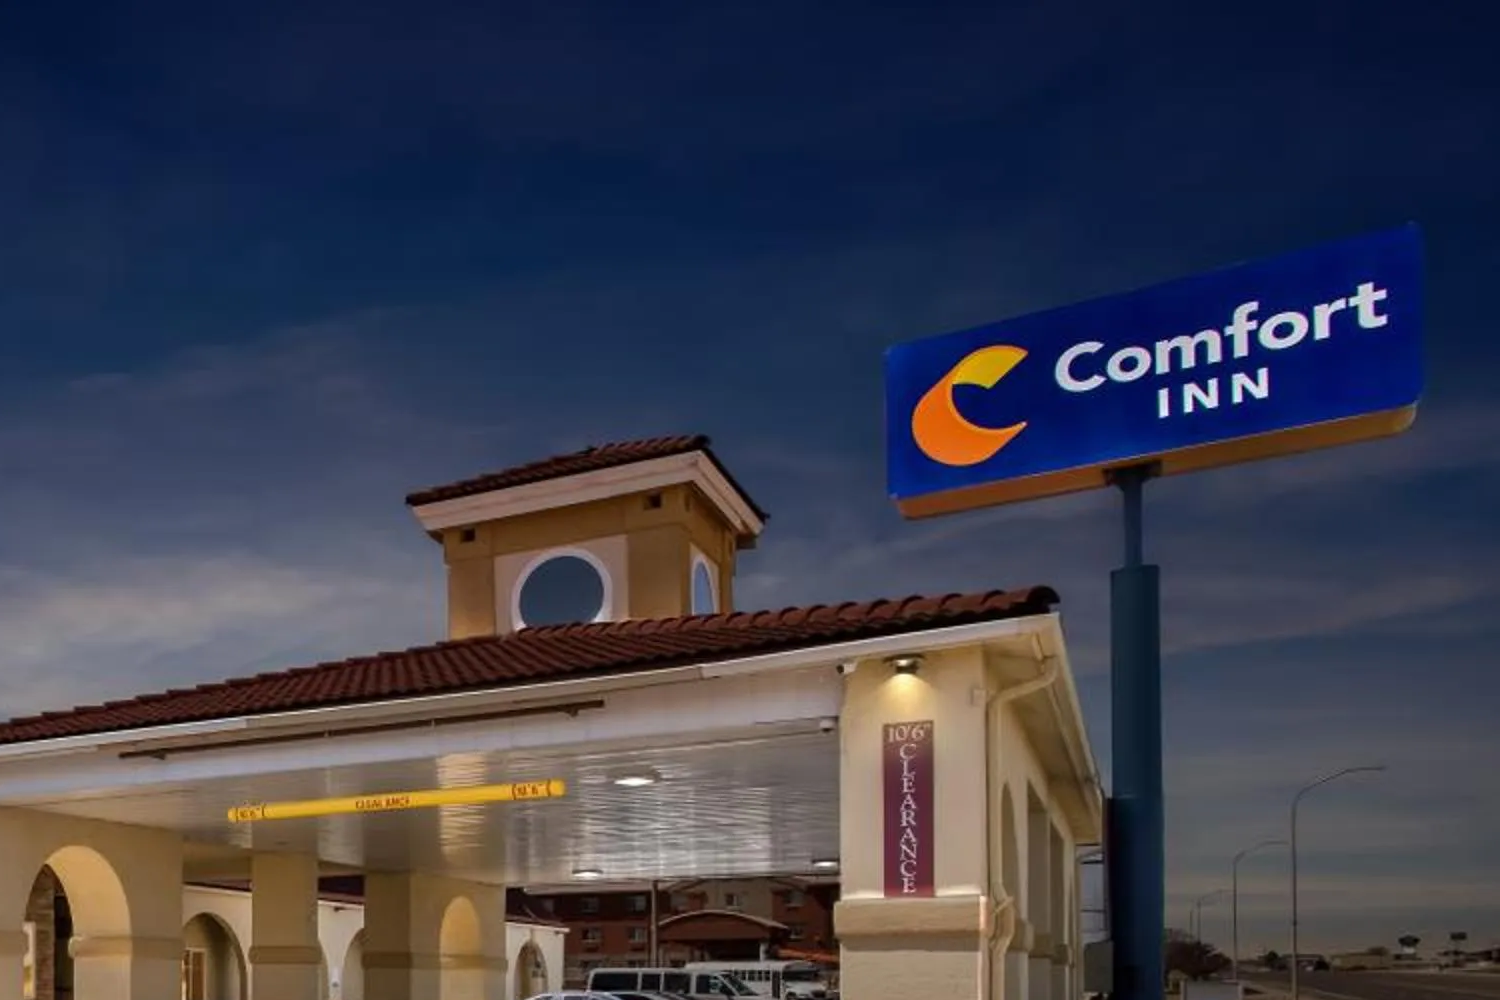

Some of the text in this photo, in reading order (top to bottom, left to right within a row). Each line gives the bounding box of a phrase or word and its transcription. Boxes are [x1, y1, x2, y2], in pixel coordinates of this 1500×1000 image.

[1055, 282, 1387, 392] Comfort
[1158, 367, 1269, 418] INN
[899, 743, 917, 894] CLEARANCE
